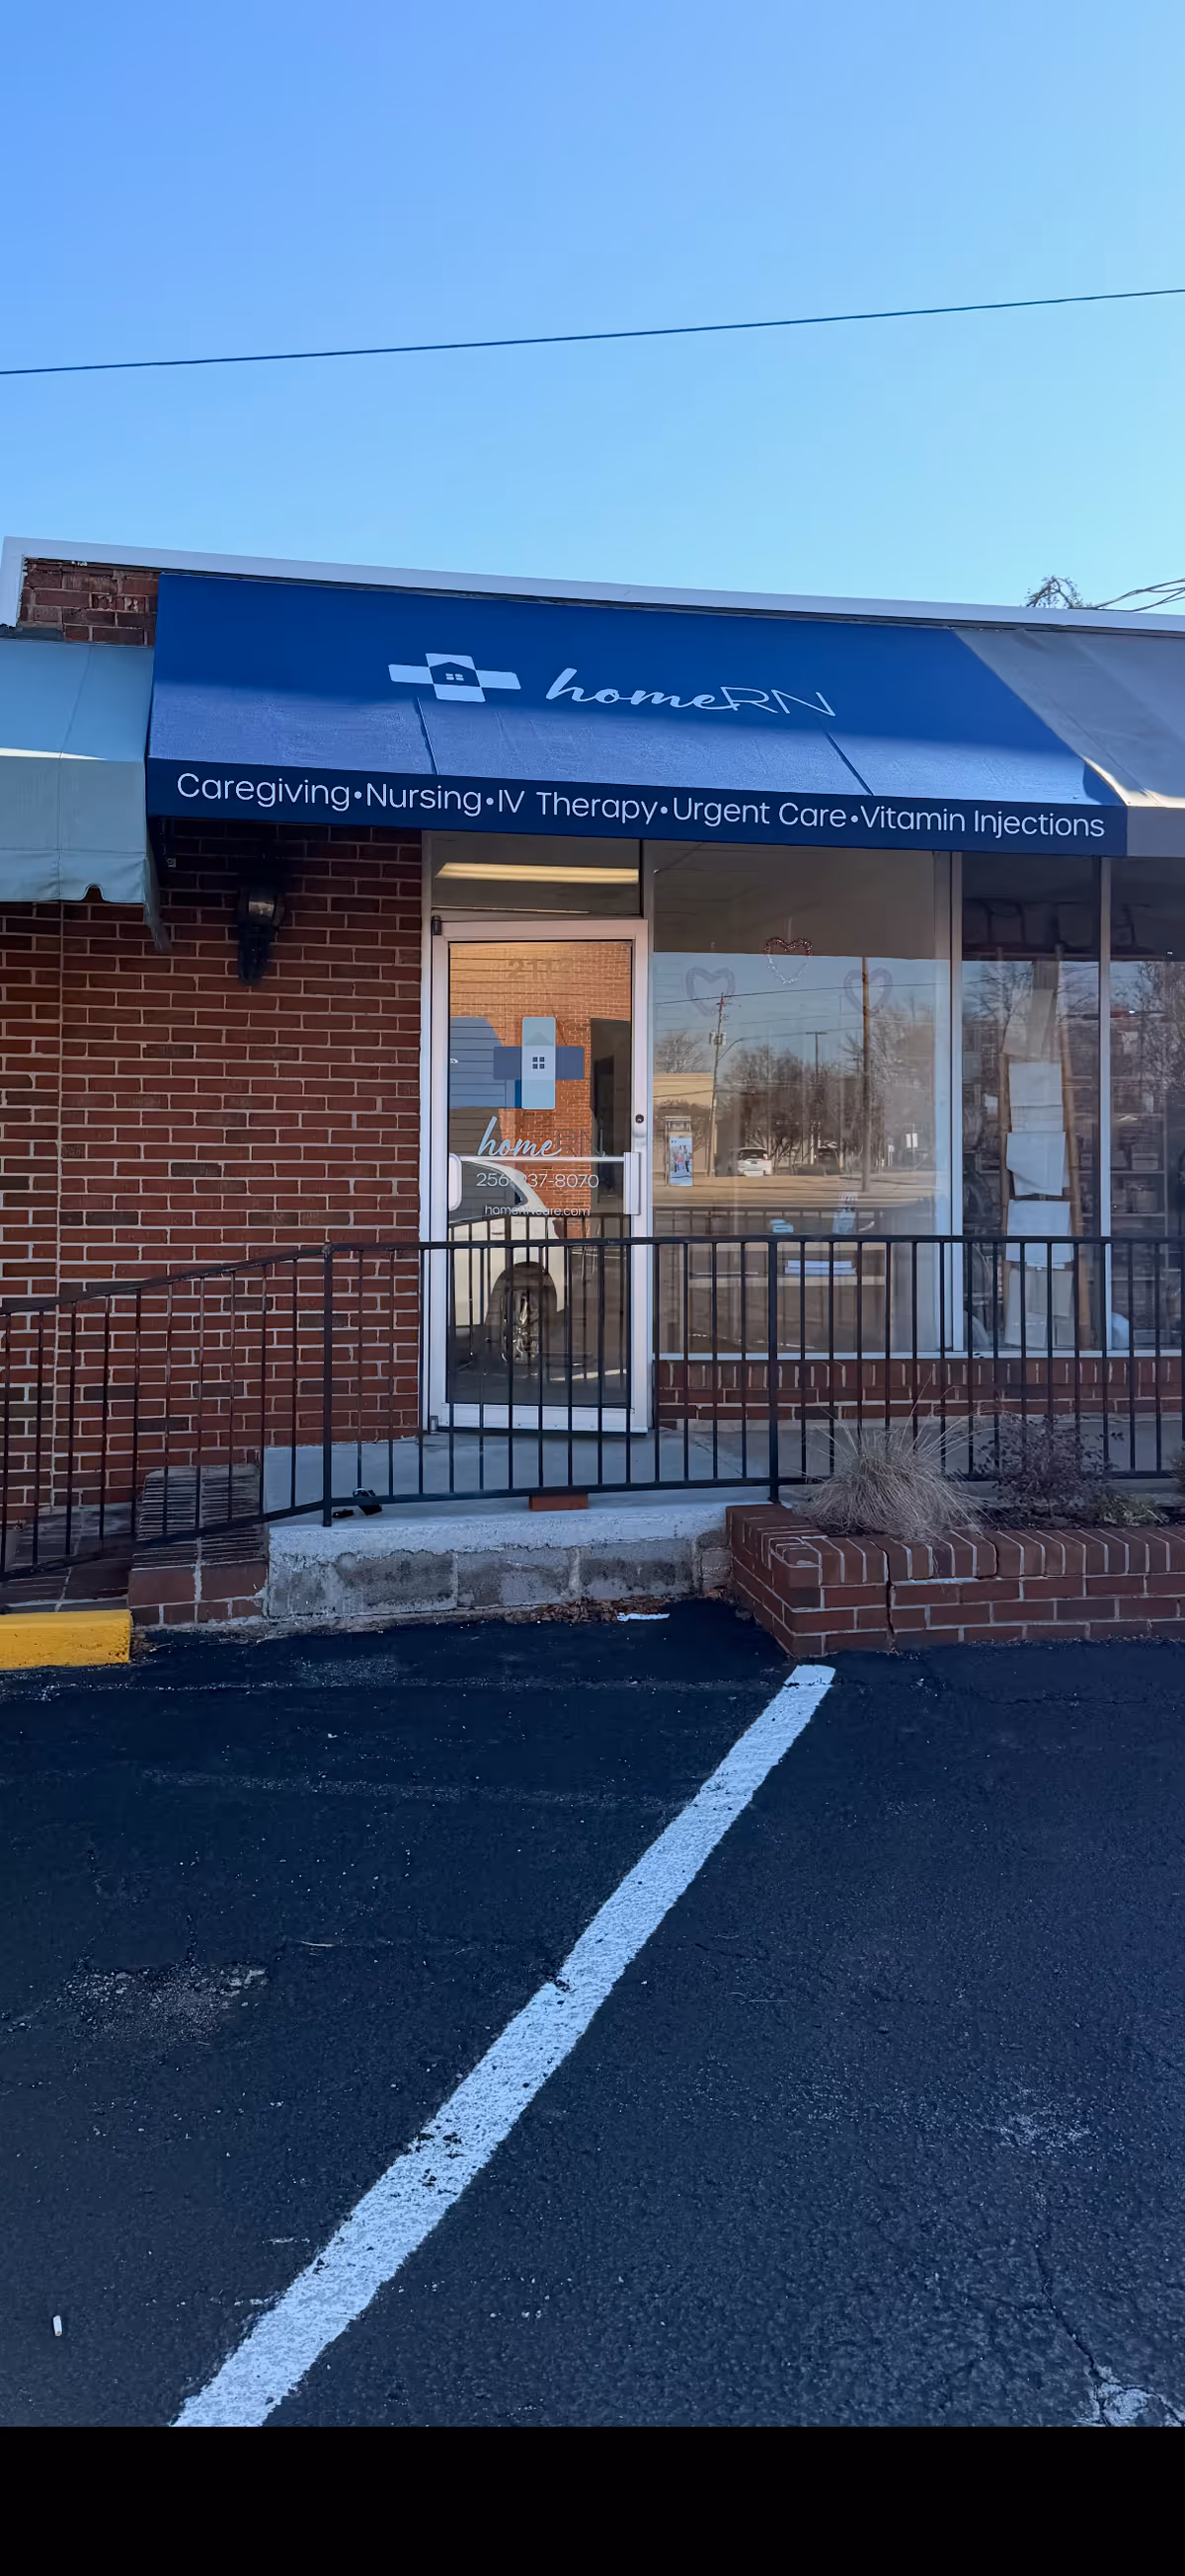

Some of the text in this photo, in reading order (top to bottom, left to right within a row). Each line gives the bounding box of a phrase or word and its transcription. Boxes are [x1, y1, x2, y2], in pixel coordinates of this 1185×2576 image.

[545, 667, 836, 718] homeRN
[177, 772, 350, 812] Caregiving
[366, 782, 481, 818] Nursing
[535, 791, 659, 825] Therapy
[673, 797, 770, 827] Urgent
[778, 802, 847, 827] Care
[860, 805, 966, 832] Vitamin
[975, 810, 1105, 839] Injections
[476, 1172, 599, 1188] 256-37-8070
